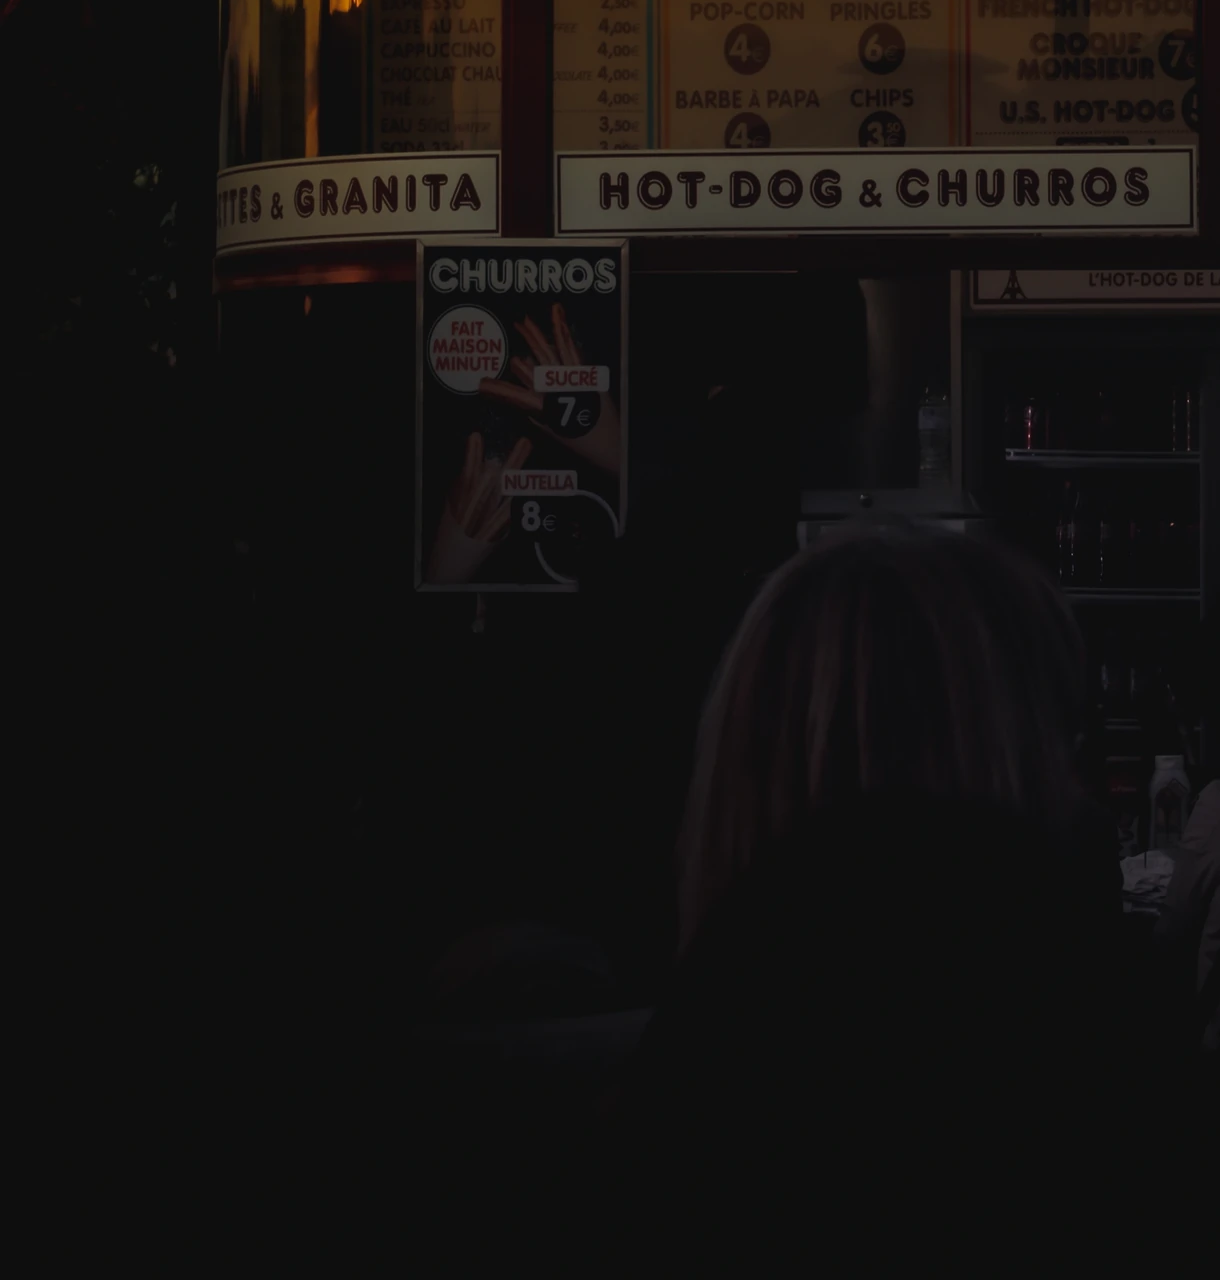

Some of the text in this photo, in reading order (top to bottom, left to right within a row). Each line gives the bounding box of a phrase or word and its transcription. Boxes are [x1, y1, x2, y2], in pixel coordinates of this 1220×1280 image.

[690, 0, 932, 21] POP-CORN PRINGLES
[428, 18, 452, 35] AU
[459, 18, 496, 34] LAIT
[598, 17, 640, 36] 4,00€
[379, 41, 640, 61] CAPPUCCINO 4,00€
[729, 32, 900, 64] 4€ 6€
[1029, 31, 1143, 56] CROQUE
[380, 65, 457, 82] CHOCOLAT
[597, 66, 640, 84] 4,00€
[1016, 57, 1155, 81] MONSIEUR
[597, 89, 640, 108] 4,00€
[675, 90, 742, 109] BARBE
[766, 89, 821, 109] PAPA
[850, 88, 915, 108] CHIPS
[1000, 99, 1047, 124] U.S.
[1053, 99, 1176, 123] HOT-DOG
[380, 117, 412, 133] EAU
[599, 116, 640, 135] 3,50€
[270, 191, 283, 220] &
[294, 173, 481, 218] GRANITA
[600, 167, 1150, 211] HOT-DOG & CHURROS
[429, 256, 618, 294] CHURROS
[1088, 270, 1179, 287] L'HOT-DOG
[1183, 271, 1205, 287] DE
[451, 321, 485, 337] FAIT
[432, 338, 502, 354] MAISON
[435, 356, 500, 372] MINUTE
[544, 367, 598, 386] SUCRÉ
[556, 396, 592, 427] 7€
[504, 474, 575, 491] NUTELLA
[520, 500, 557, 533] 8€
